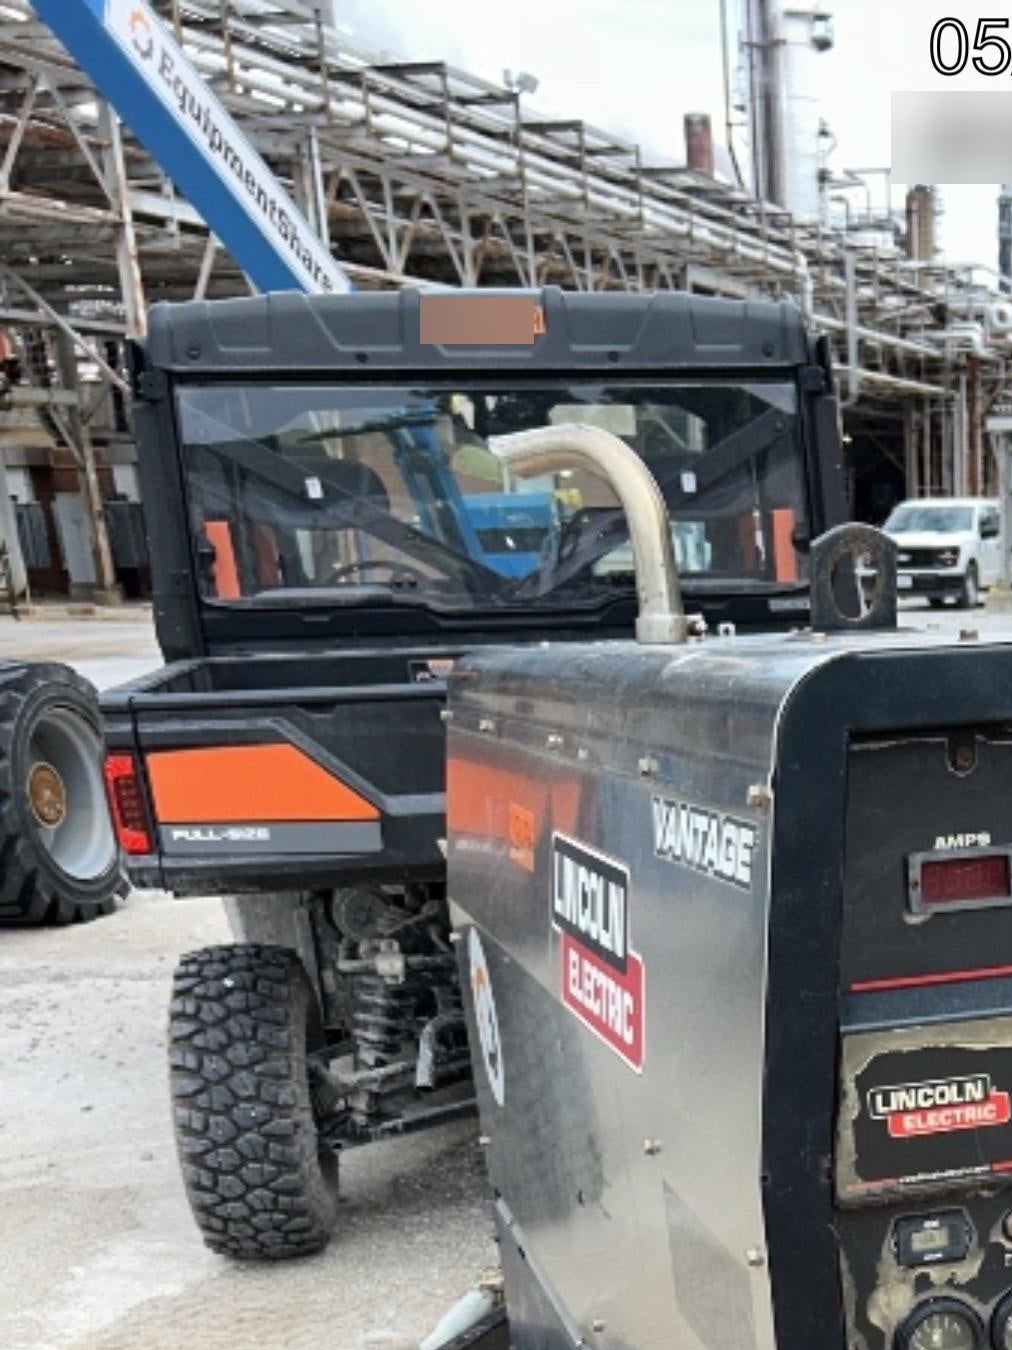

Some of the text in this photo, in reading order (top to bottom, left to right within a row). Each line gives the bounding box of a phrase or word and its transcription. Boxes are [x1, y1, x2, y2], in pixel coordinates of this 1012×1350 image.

[156, 45, 335, 293] EquipmentShare
[172, 828, 270, 841] FULL-SIZE
[653, 798, 756, 886] VANTAGE
[935, 831, 991, 849] AMPS
[554, 851, 625, 958] LINCOLN
[568, 947, 634, 1045] ELECTRIC
[875, 1080, 983, 1113] LINCOLN
[903, 1103, 997, 1130] ELECTRIC
